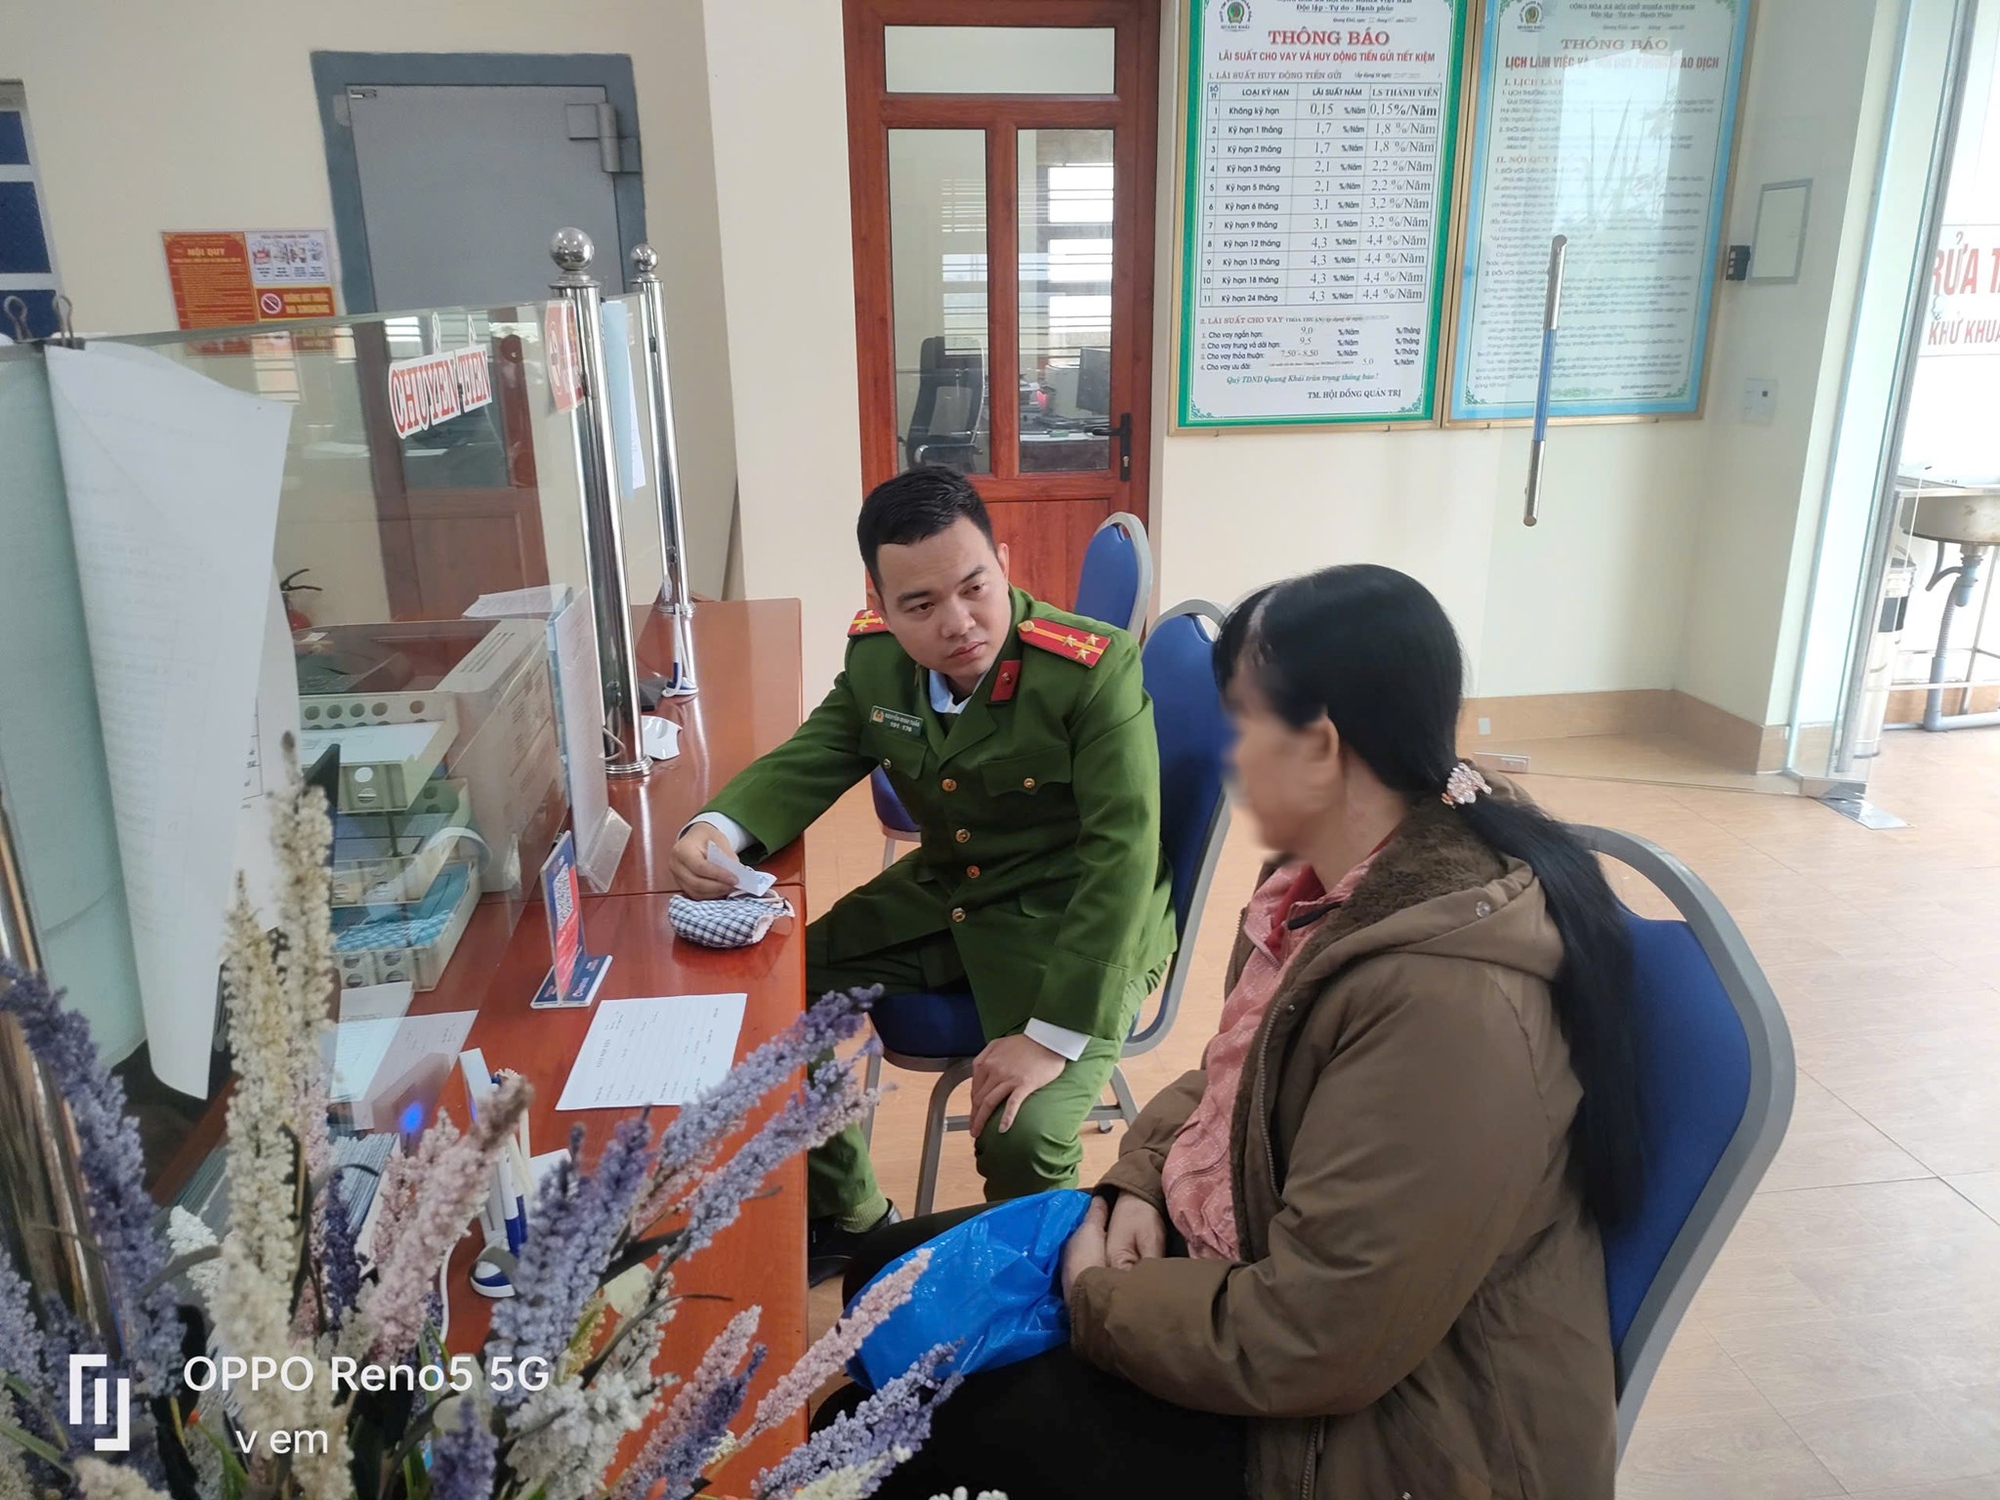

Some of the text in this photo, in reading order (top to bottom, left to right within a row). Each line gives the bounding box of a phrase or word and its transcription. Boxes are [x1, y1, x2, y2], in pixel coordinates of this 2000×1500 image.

[1268, 26, 1390, 45] THÔNG BÁO
[1561, 36, 1668, 50] THÔNG BÁO
[1219, 50, 1232, 61] LÃI
[1235, 48, 1258, 61] SUẤT
[1260, 52, 1277, 60] CHO
[1280, 52, 1297, 60] VAY
[1300, 50, 1311, 60] VÀ
[1314, 52, 1331, 60] HUY
[1333, 50, 1357, 63] ĐỘNG
[1397, 49, 1413, 61] TIẾT
[1415, 50, 1435, 63] KIỆM
[1505, 56, 1527, 70] LỊCH
[1697, 56, 1719, 70] DỊCH
[1242, 89, 1260, 97] LOẠI
[1312, 87, 1362, 95] LÃI SUẤT NĂM
[1229, 107, 1252, 116] Không
[1265, 108, 1279, 116] hạn
[1310, 103, 1333, 115] 0,15
[1262, 126, 1283, 135] tháng
[1261, 145, 1282, 154] tháng
[1238, 165, 1251, 173] hạn
[1260, 164, 1281, 173] tháng
[1259, 183, 1280, 192] tháng
[1258, 202, 1278, 211] tháng
[1257, 221, 1277, 229] tháng
[1260, 240, 1280, 248] tháng
[1260, 258, 1280, 266] tháng
[1259, 276, 1279, 284] tháng
[1258, 294, 1278, 303] tháng
